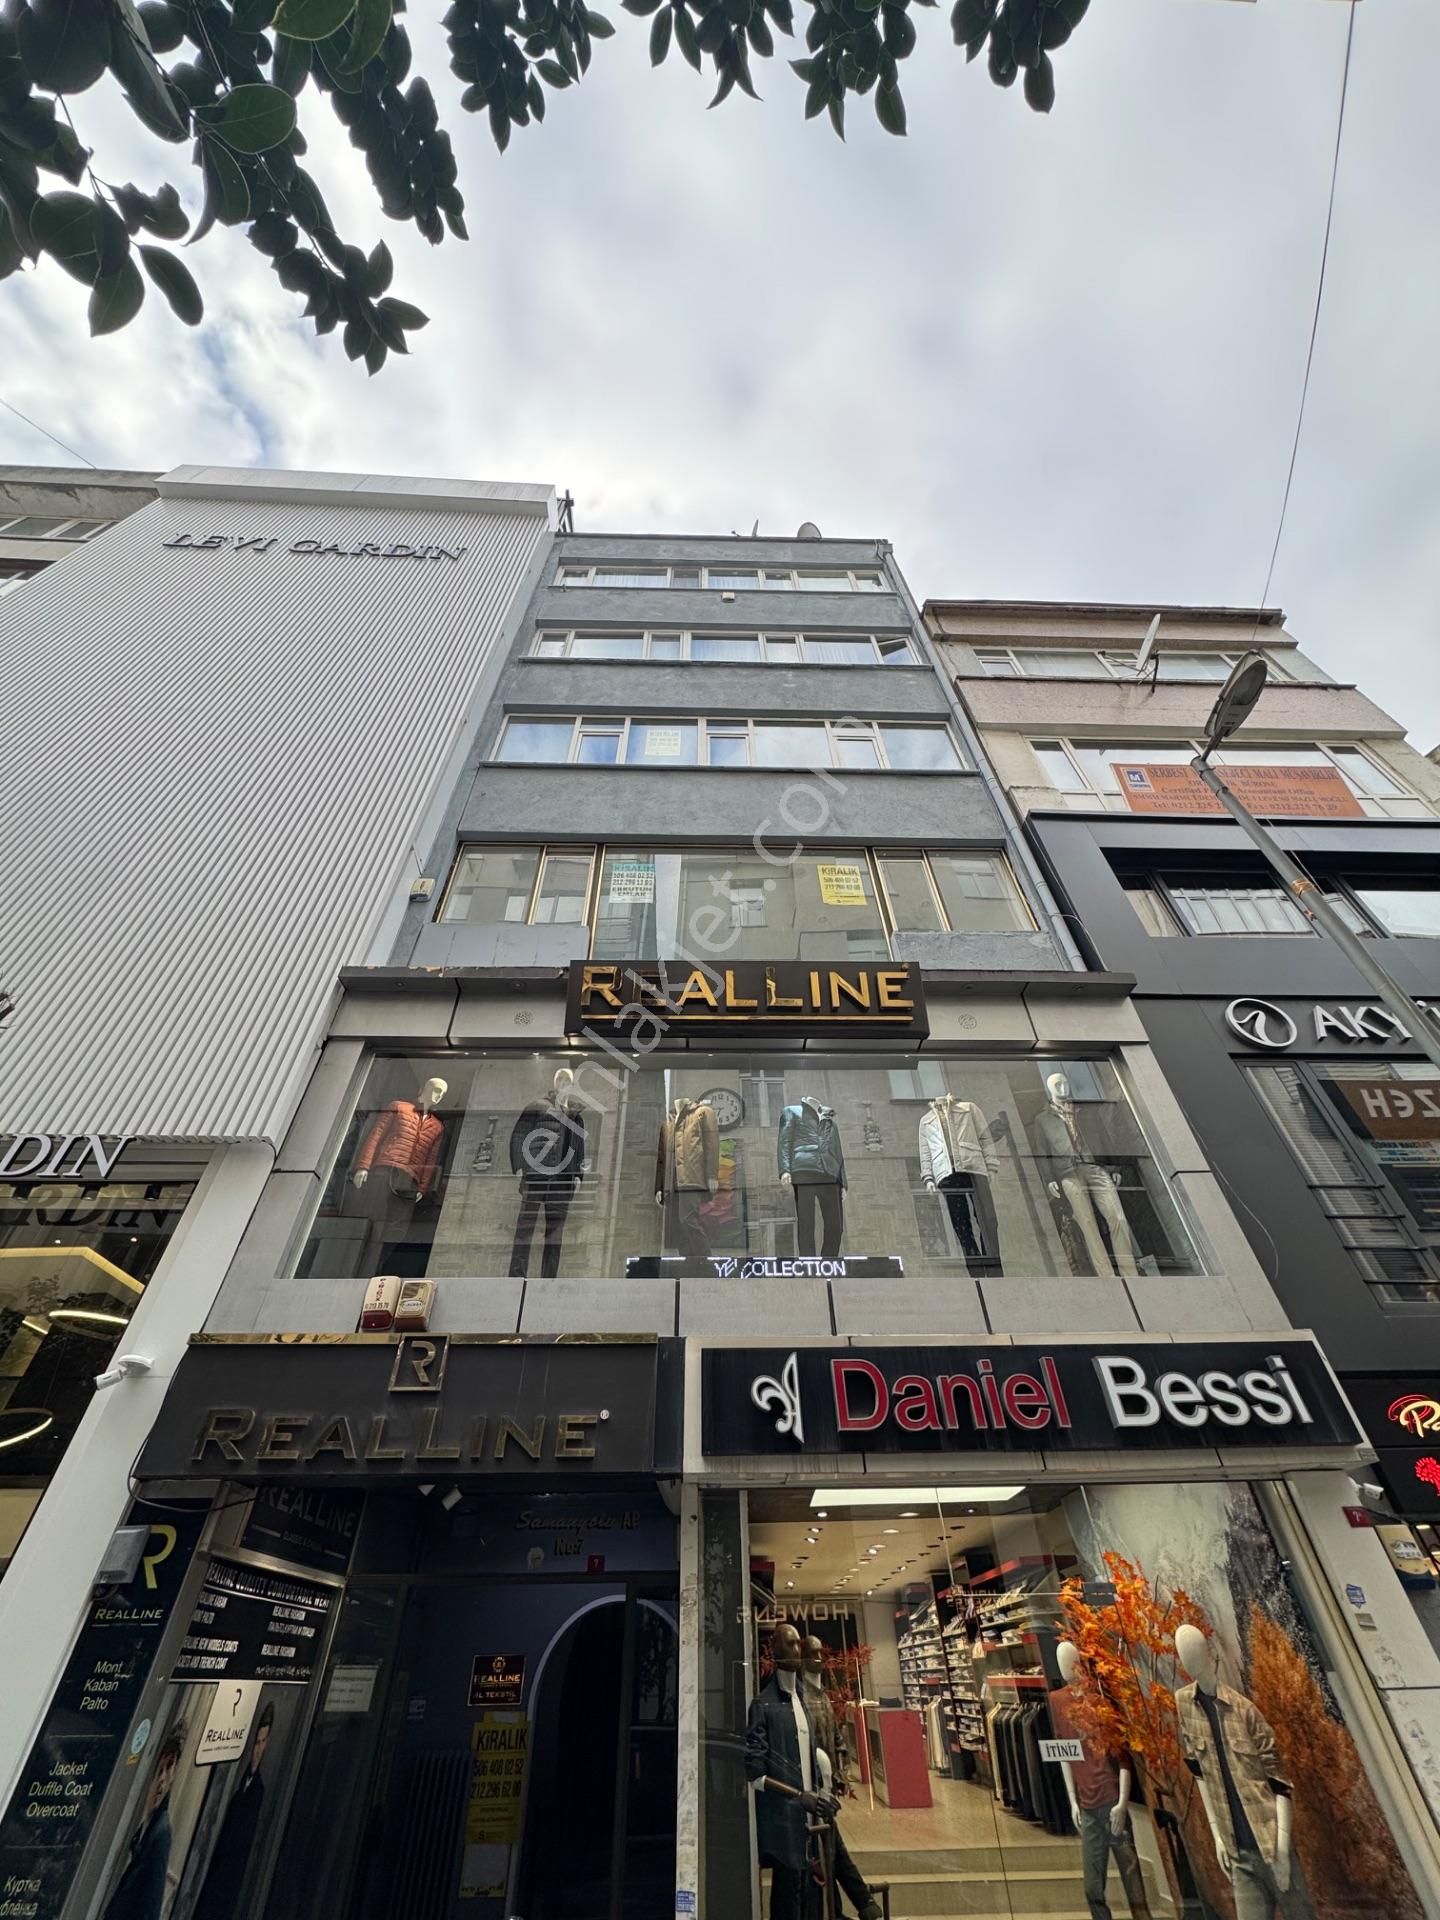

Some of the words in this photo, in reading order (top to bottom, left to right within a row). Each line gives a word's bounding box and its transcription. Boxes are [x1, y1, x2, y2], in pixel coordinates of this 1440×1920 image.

[162, 533, 278, 552] LEVI
[288, 540, 467, 562] GARDIN
[581, 964, 914, 1012] REALLINE
[740, 1260, 876, 1279] COLLECTION
[830, 1356, 1072, 1433] Daniel
[1092, 1354, 1314, 1429] Bessi
[191, 1406, 600, 1461] REALLINE
[95, 1608, 164, 1620] REALLINE
[94, 1660, 124, 1674] Mont
[84, 1679, 119, 1691] Kaban
[473, 1673, 521, 1685] REALLINE
[80, 1696, 109, 1710] Palto
[205, 1727, 245, 1743] REALLINE
[1045, 1742, 1080, 1758] İTİNİZ
[48, 1760, 89, 1776] Jacket
[28, 1780, 63, 1797] Duffle
[64, 1780, 94, 1796] Coat
[26, 1801, 81, 1818] Overcoat
[3, 1874, 42, 1897] Куртка
